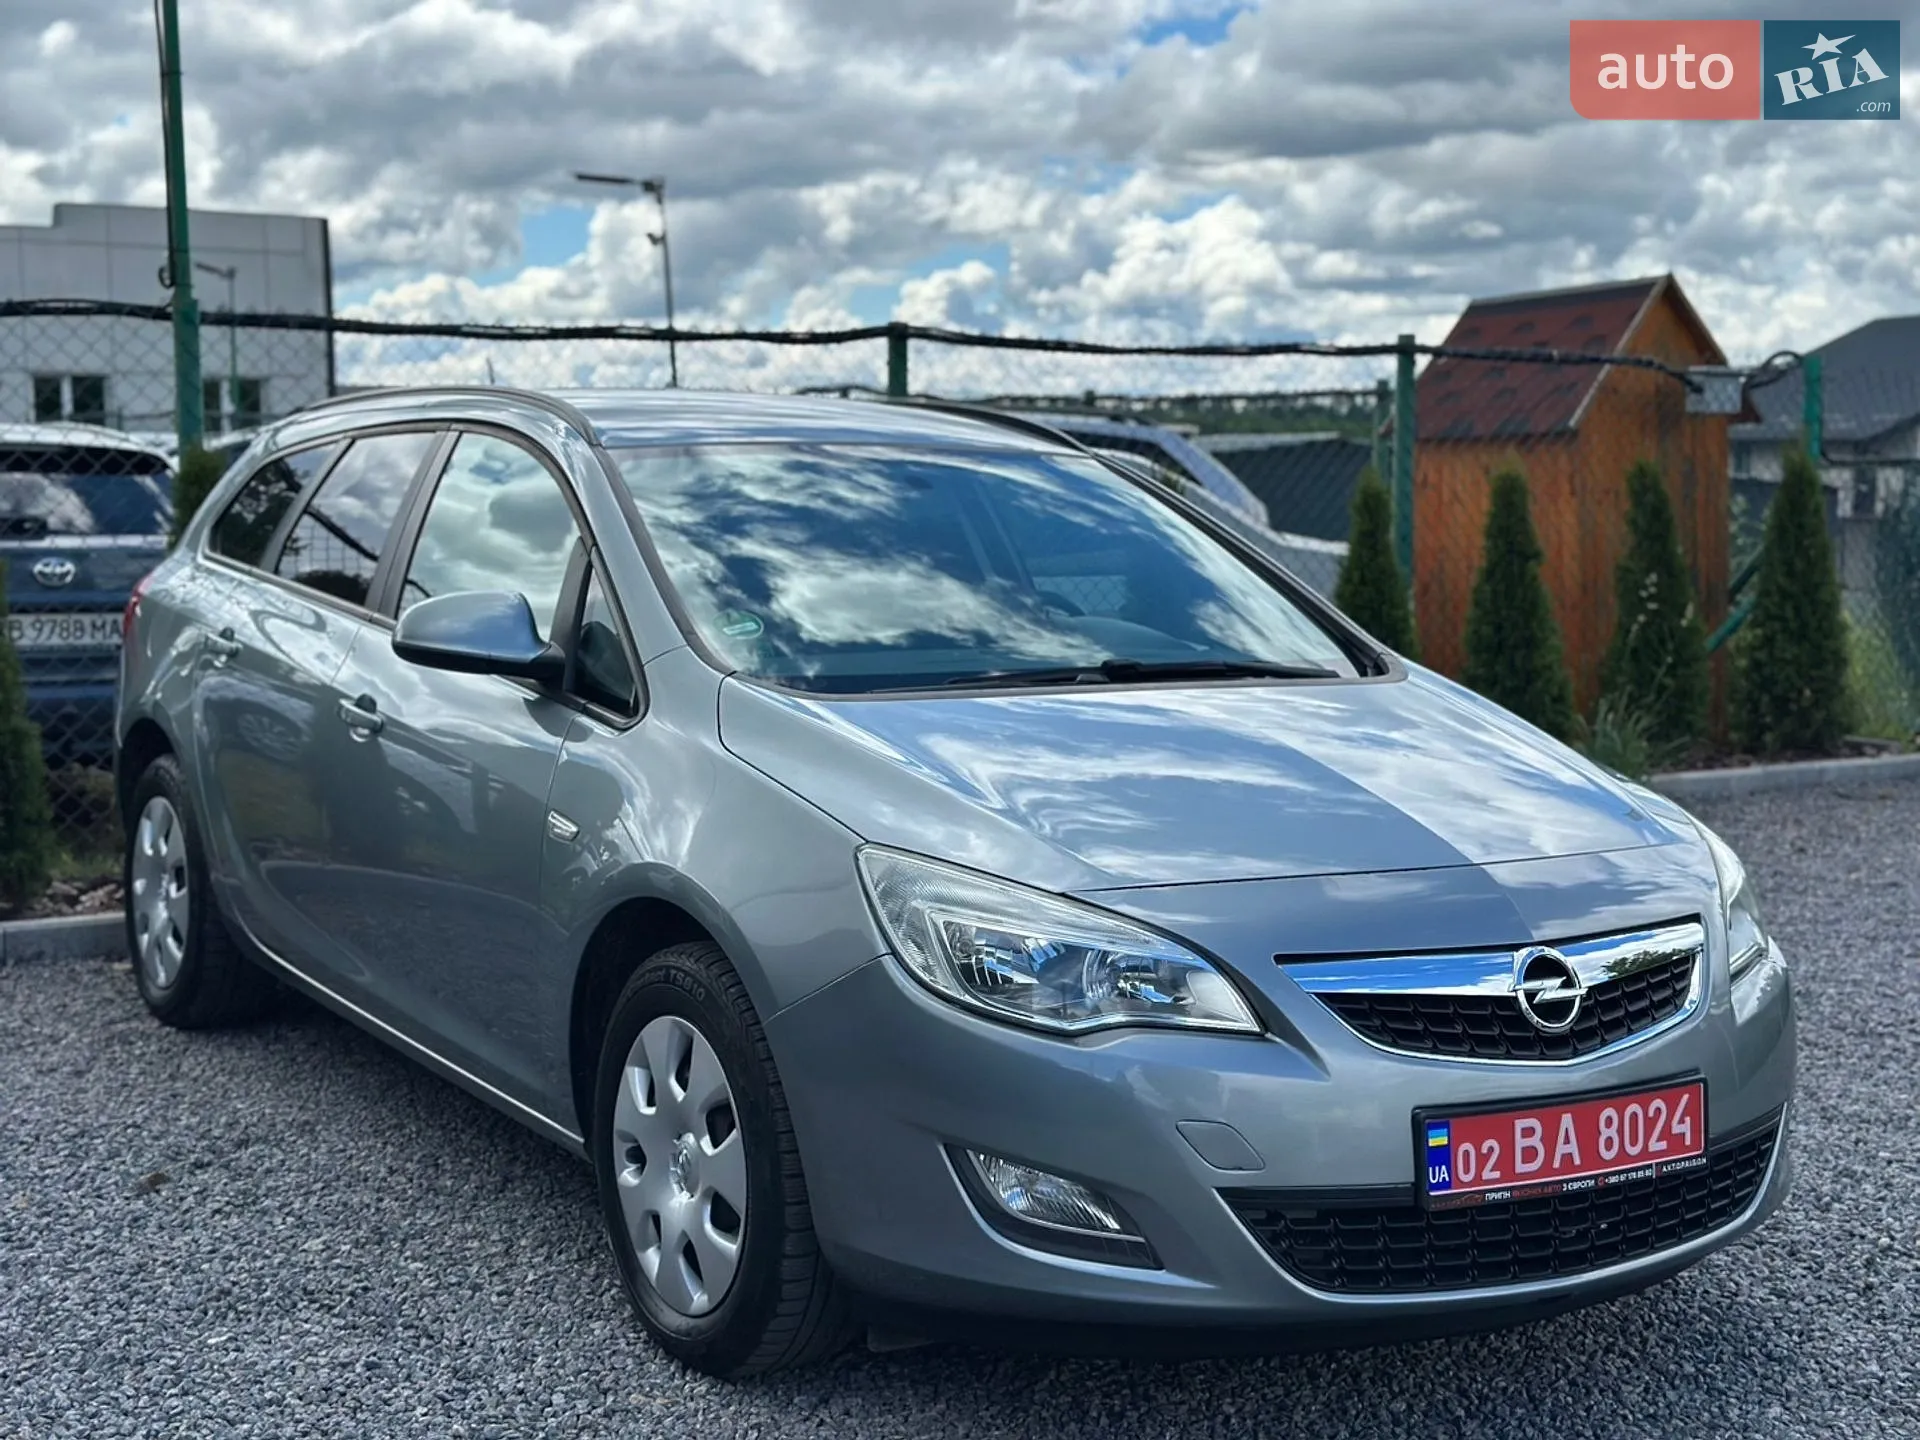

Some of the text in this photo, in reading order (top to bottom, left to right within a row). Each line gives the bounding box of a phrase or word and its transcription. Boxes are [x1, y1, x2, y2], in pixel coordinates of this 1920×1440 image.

[90, 618, 122, 641] MA
[1456, 1093, 1691, 1183] 02 BA 8024
[1428, 1164, 1450, 1184] UA
